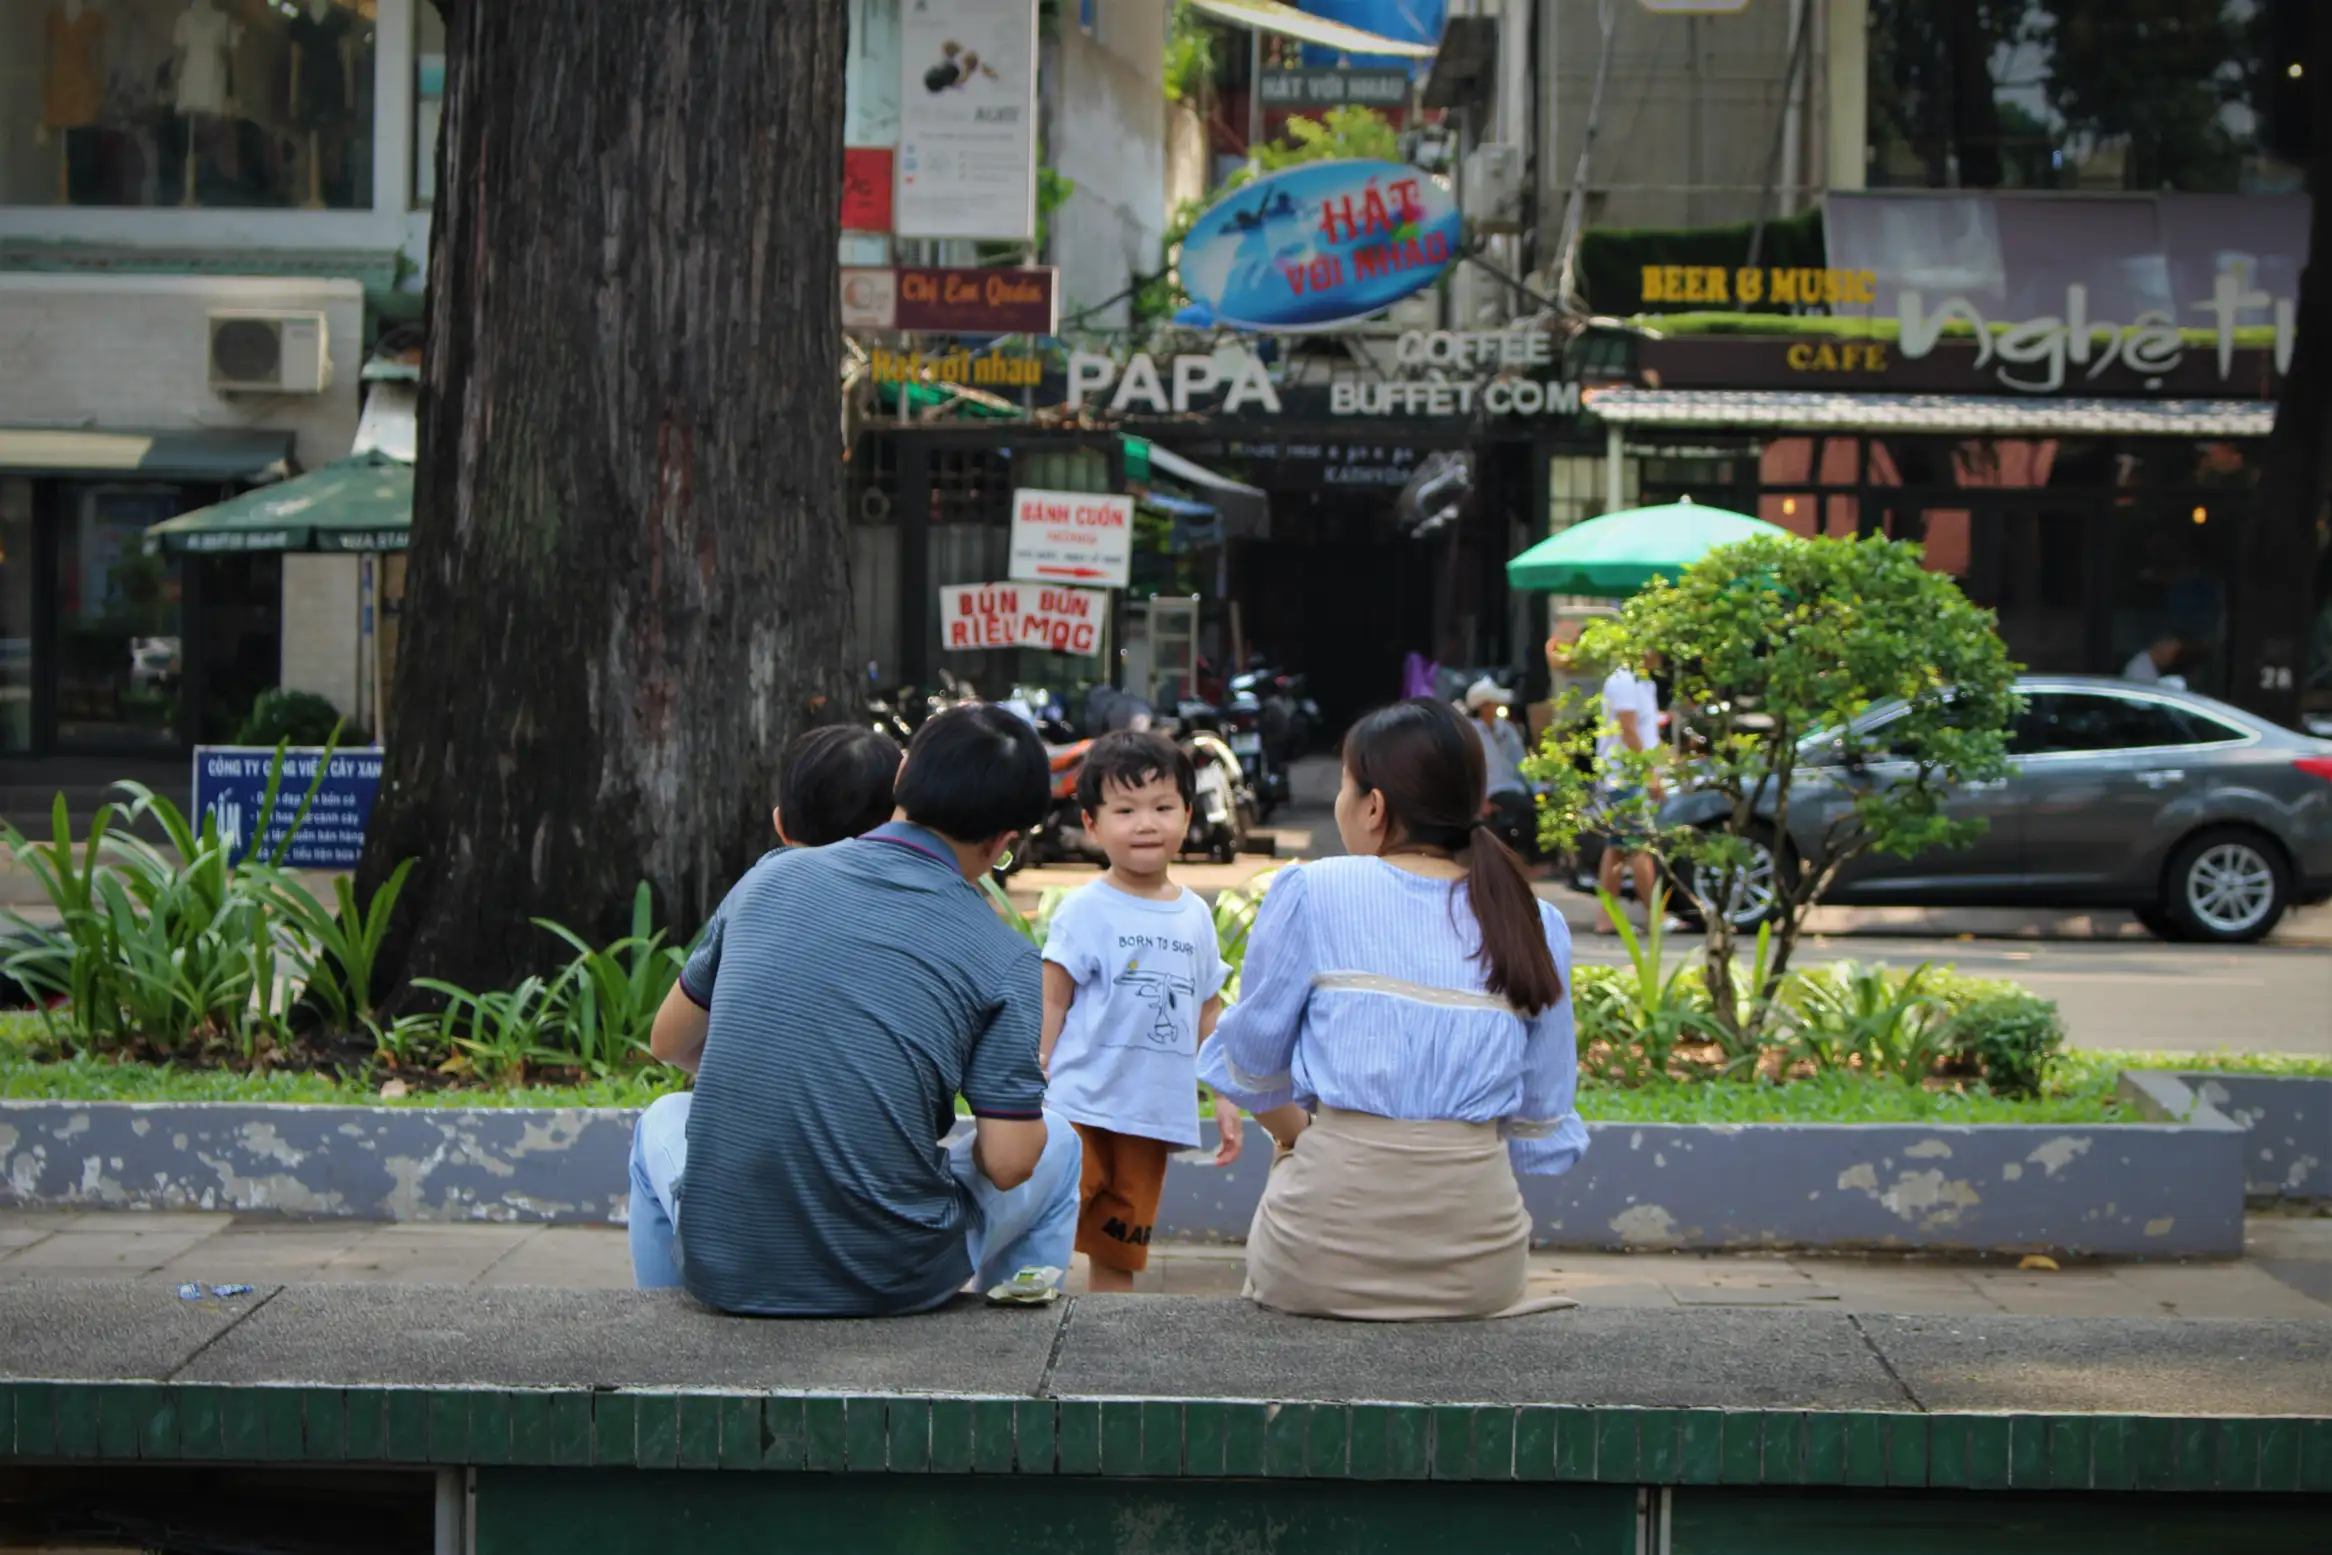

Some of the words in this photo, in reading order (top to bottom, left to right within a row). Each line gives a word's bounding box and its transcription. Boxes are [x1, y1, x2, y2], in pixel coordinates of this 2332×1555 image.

[1641, 265, 1729, 302] BEER
[1736, 266, 1763, 304] &
[1770, 267, 1876, 304] MUSIC
[1397, 331, 1552, 370] COFFEE
[1787, 344, 1887, 371] CAFE
[973, 349, 1042, 386] nhau
[1066, 352, 1282, 414] PAPA
[1021, 502, 1070, 523] BÁNH
[244, 759, 261, 777] TY
[1118, 936, 1154, 949] BORN
[1156, 936, 1169, 950] TO
